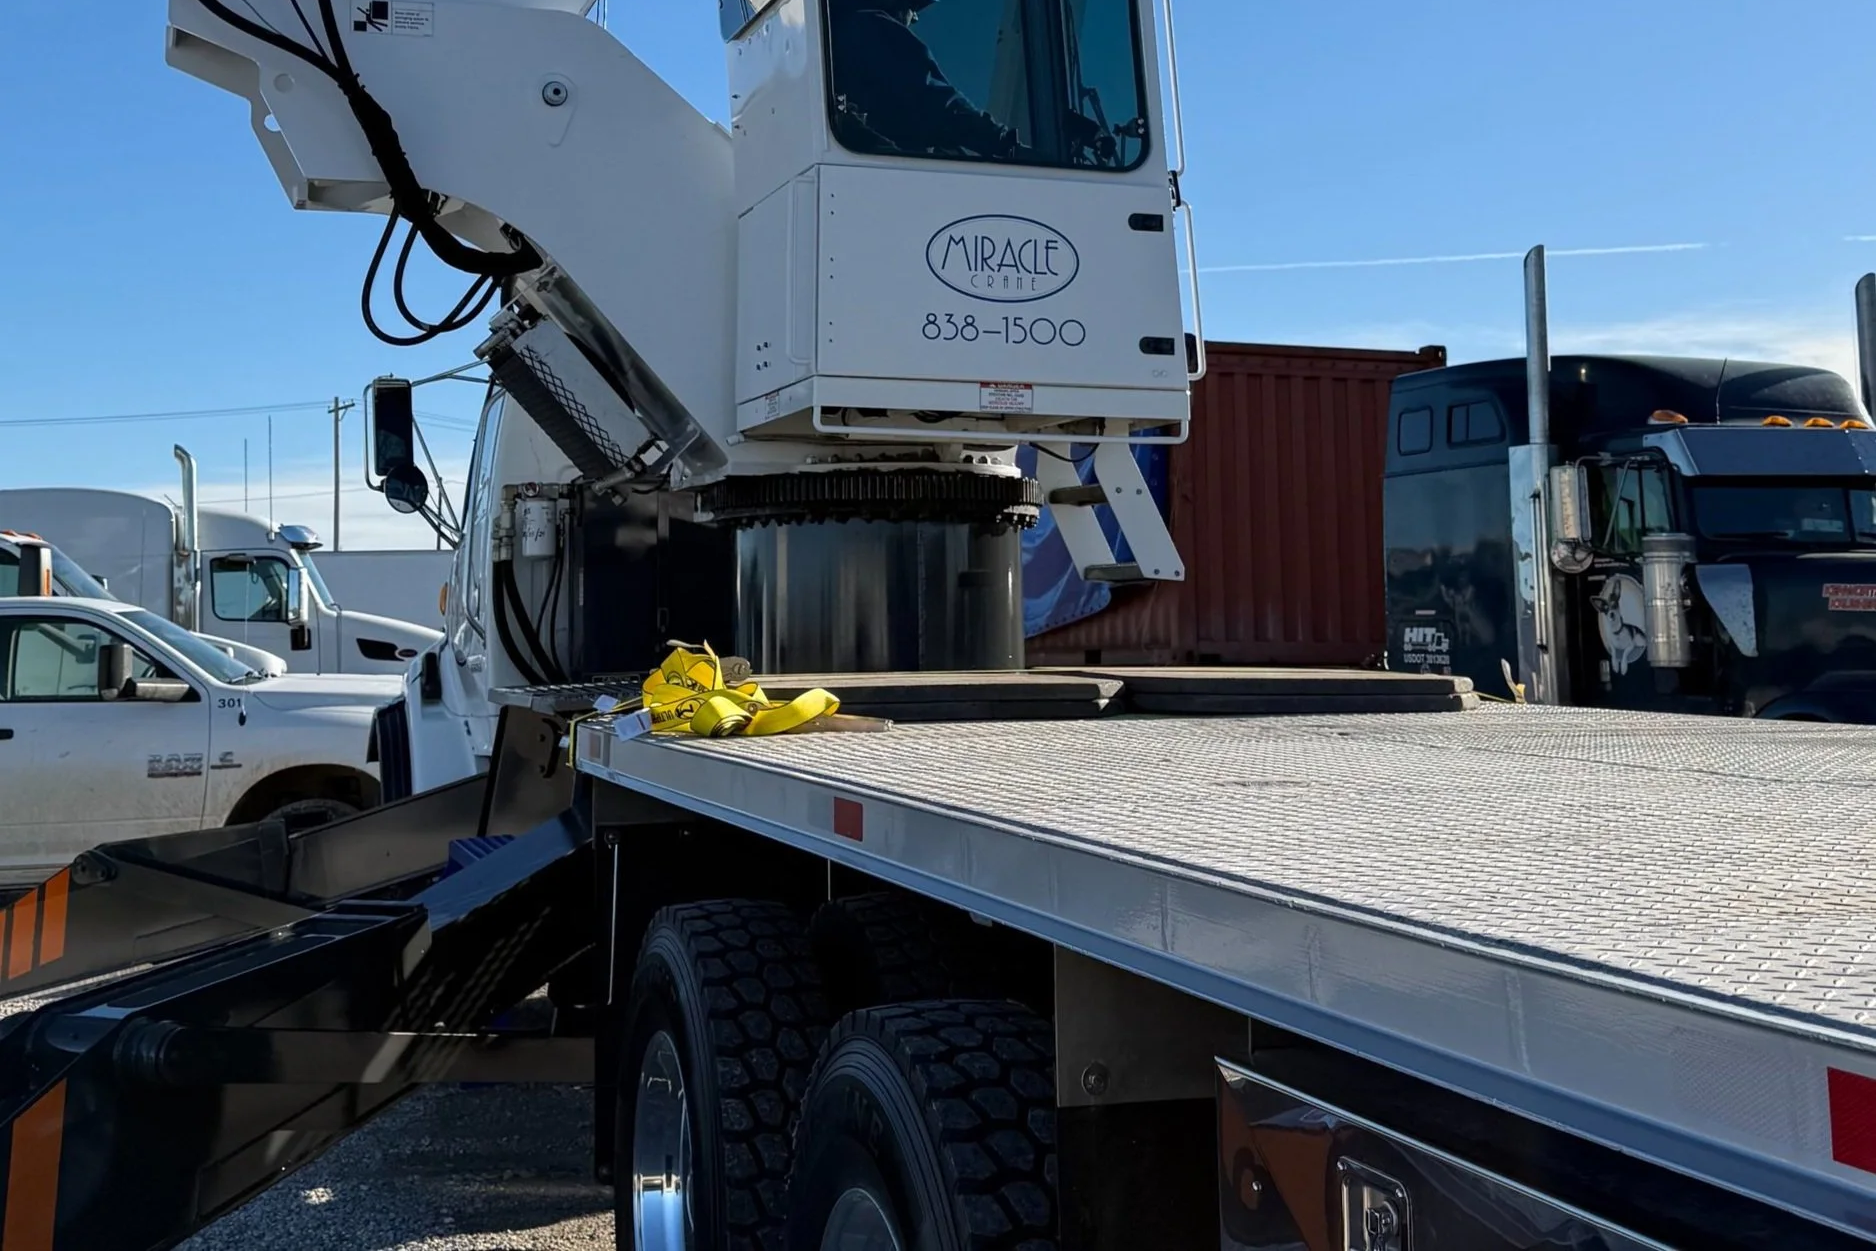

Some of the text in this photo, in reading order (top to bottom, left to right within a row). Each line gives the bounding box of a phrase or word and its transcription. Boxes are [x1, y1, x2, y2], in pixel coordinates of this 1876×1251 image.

[941, 234, 1059, 276] MIRACLE
[970, 274, 1037, 291] CRANE
[922, 313, 1086, 347] 838-1500
[1404, 627, 1436, 642] HIT
[217, 698, 241, 708] 301
